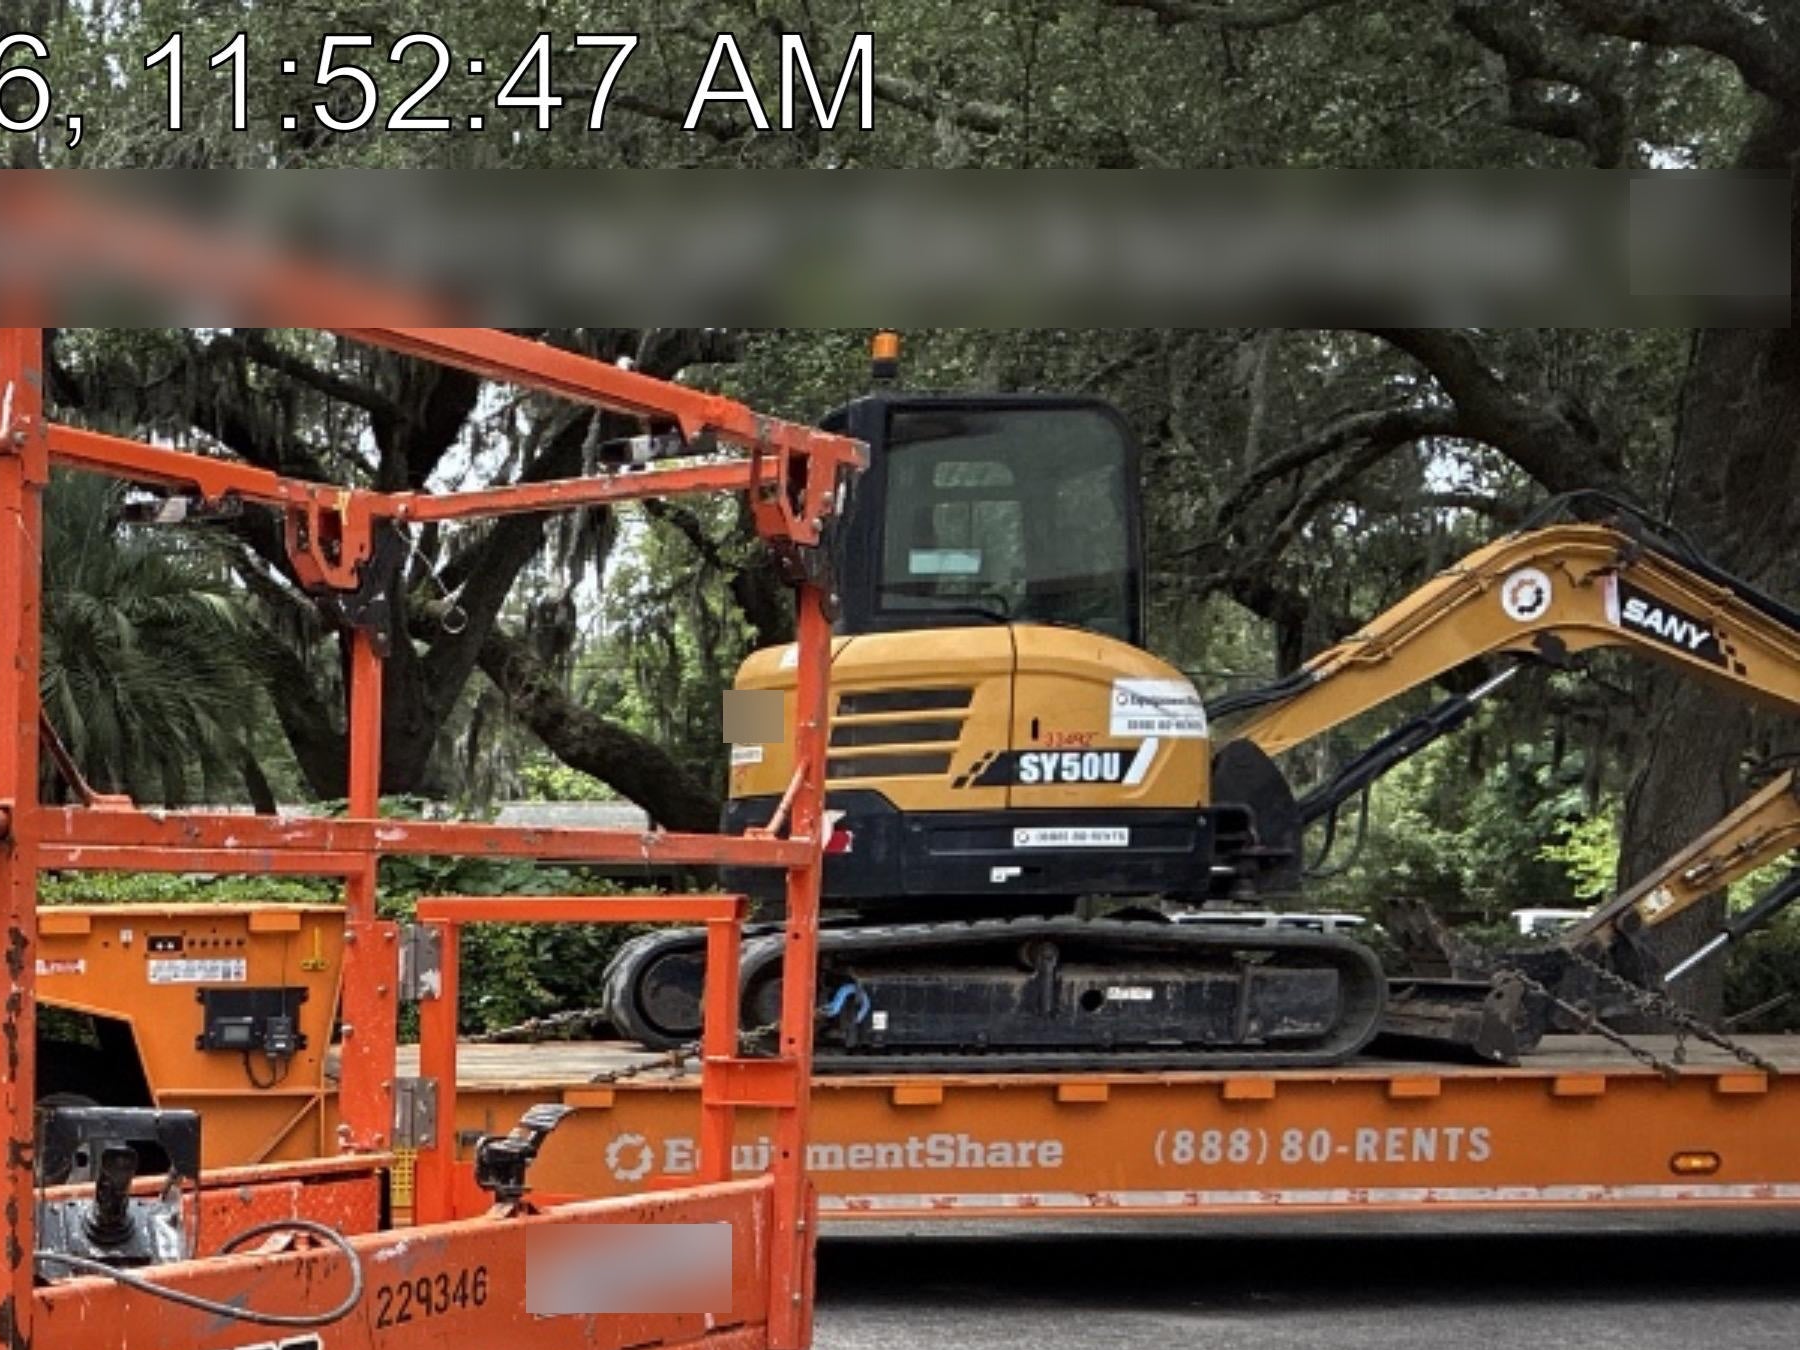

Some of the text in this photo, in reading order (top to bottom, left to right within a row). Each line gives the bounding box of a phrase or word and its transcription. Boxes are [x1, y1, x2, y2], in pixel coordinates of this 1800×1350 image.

[1622, 597, 1711, 650] SANY
[1018, 751, 1121, 784] SY50U
[662, 1133, 1064, 1172] EuimentShare
[1279, 1126, 1492, 1164] 80-RENTS
[376, 1265, 488, 1329] 229346
